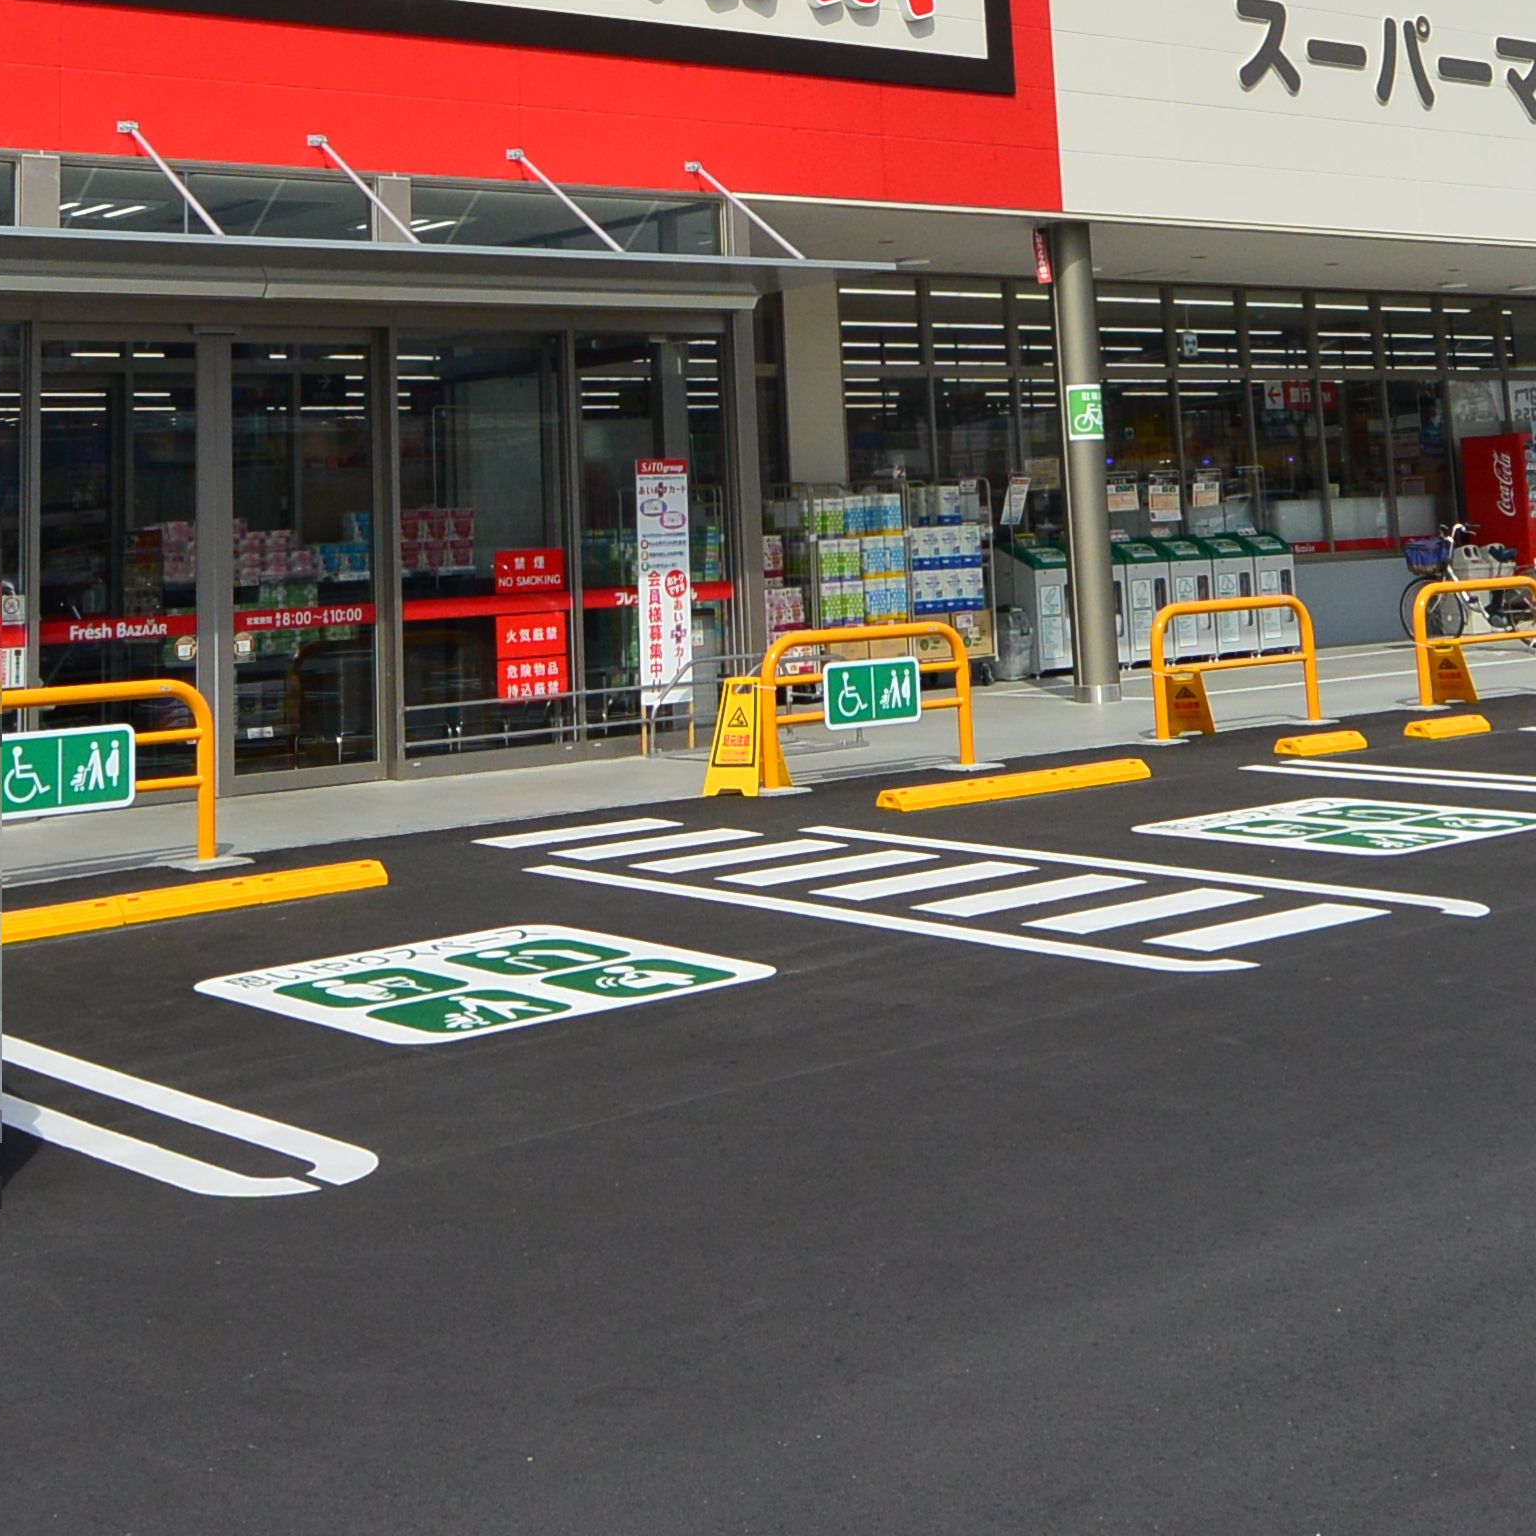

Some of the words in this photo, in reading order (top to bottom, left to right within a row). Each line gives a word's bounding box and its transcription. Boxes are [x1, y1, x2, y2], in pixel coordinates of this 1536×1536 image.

[498, 577, 513, 587] NO
[516, 574, 561, 587] SMOKING
[505, 626, 558, 644] 火気厳禁
[224, 927, 549, 990] 思いやりスペース
